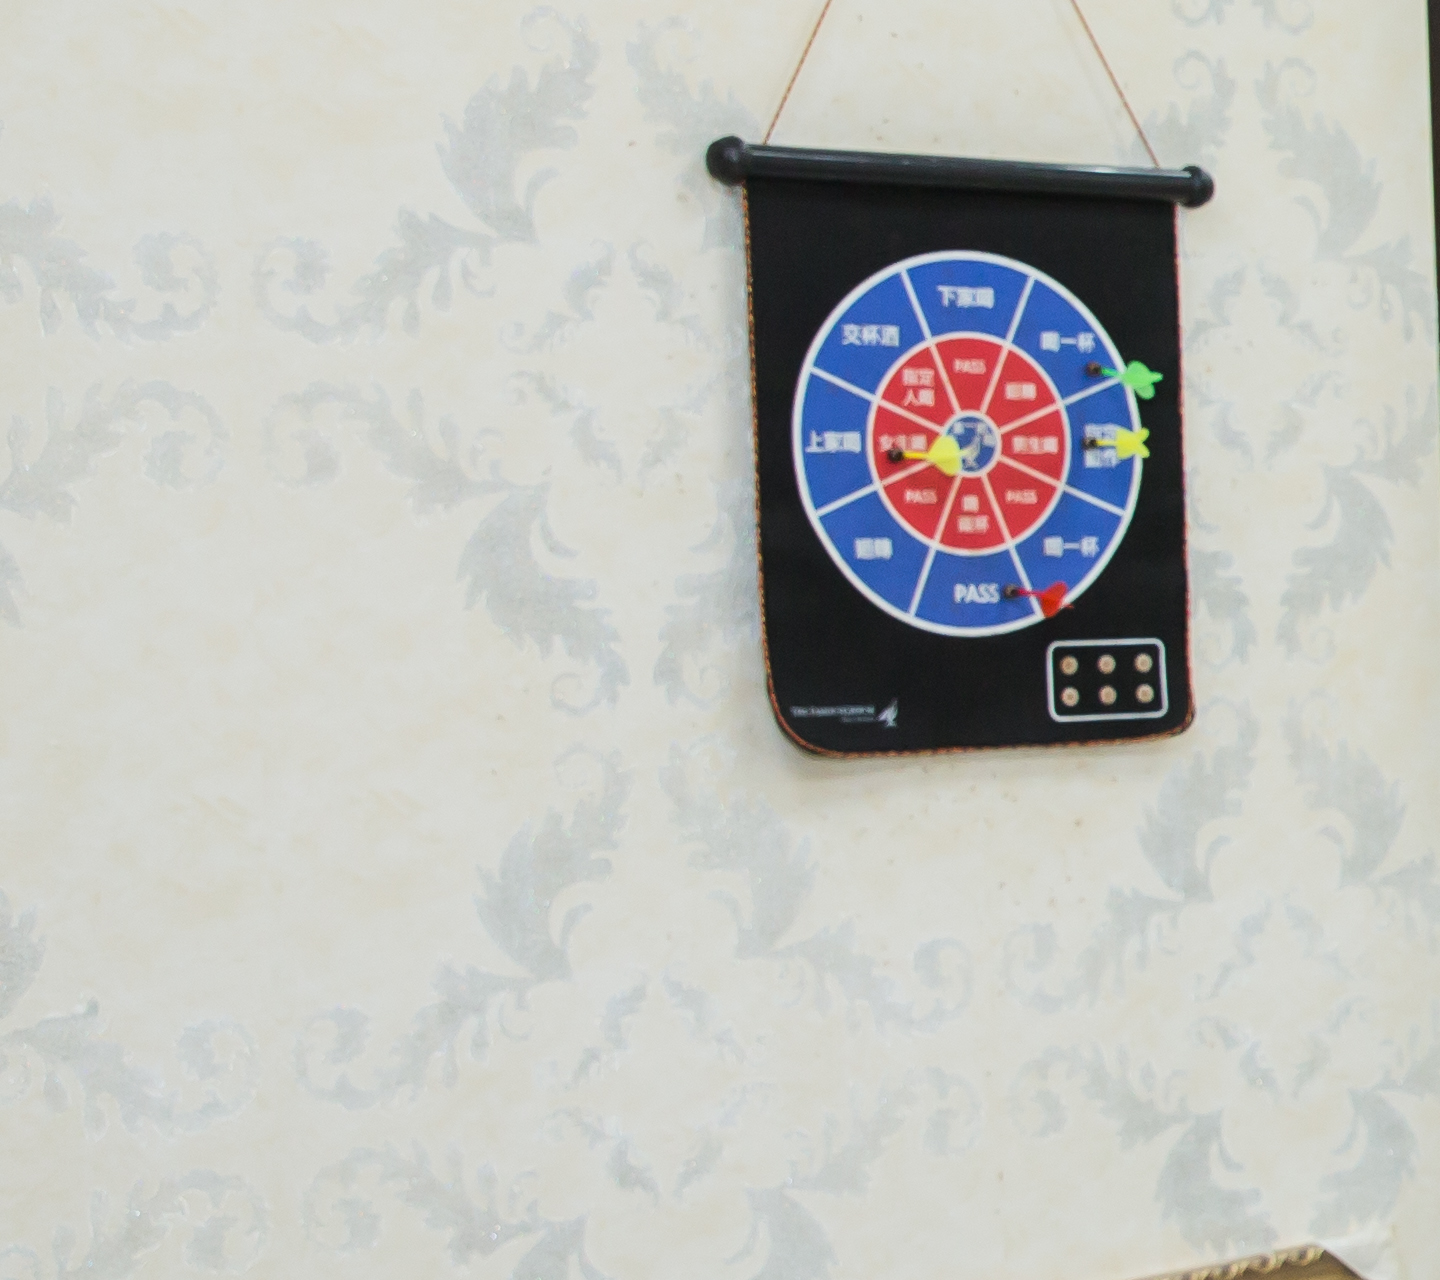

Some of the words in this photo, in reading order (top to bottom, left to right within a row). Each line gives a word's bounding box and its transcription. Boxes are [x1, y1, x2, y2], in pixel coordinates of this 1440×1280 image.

[904, 489, 938, 505] PASS
[1005, 489, 1038, 505] PASS
[953, 583, 999, 604] PASS
